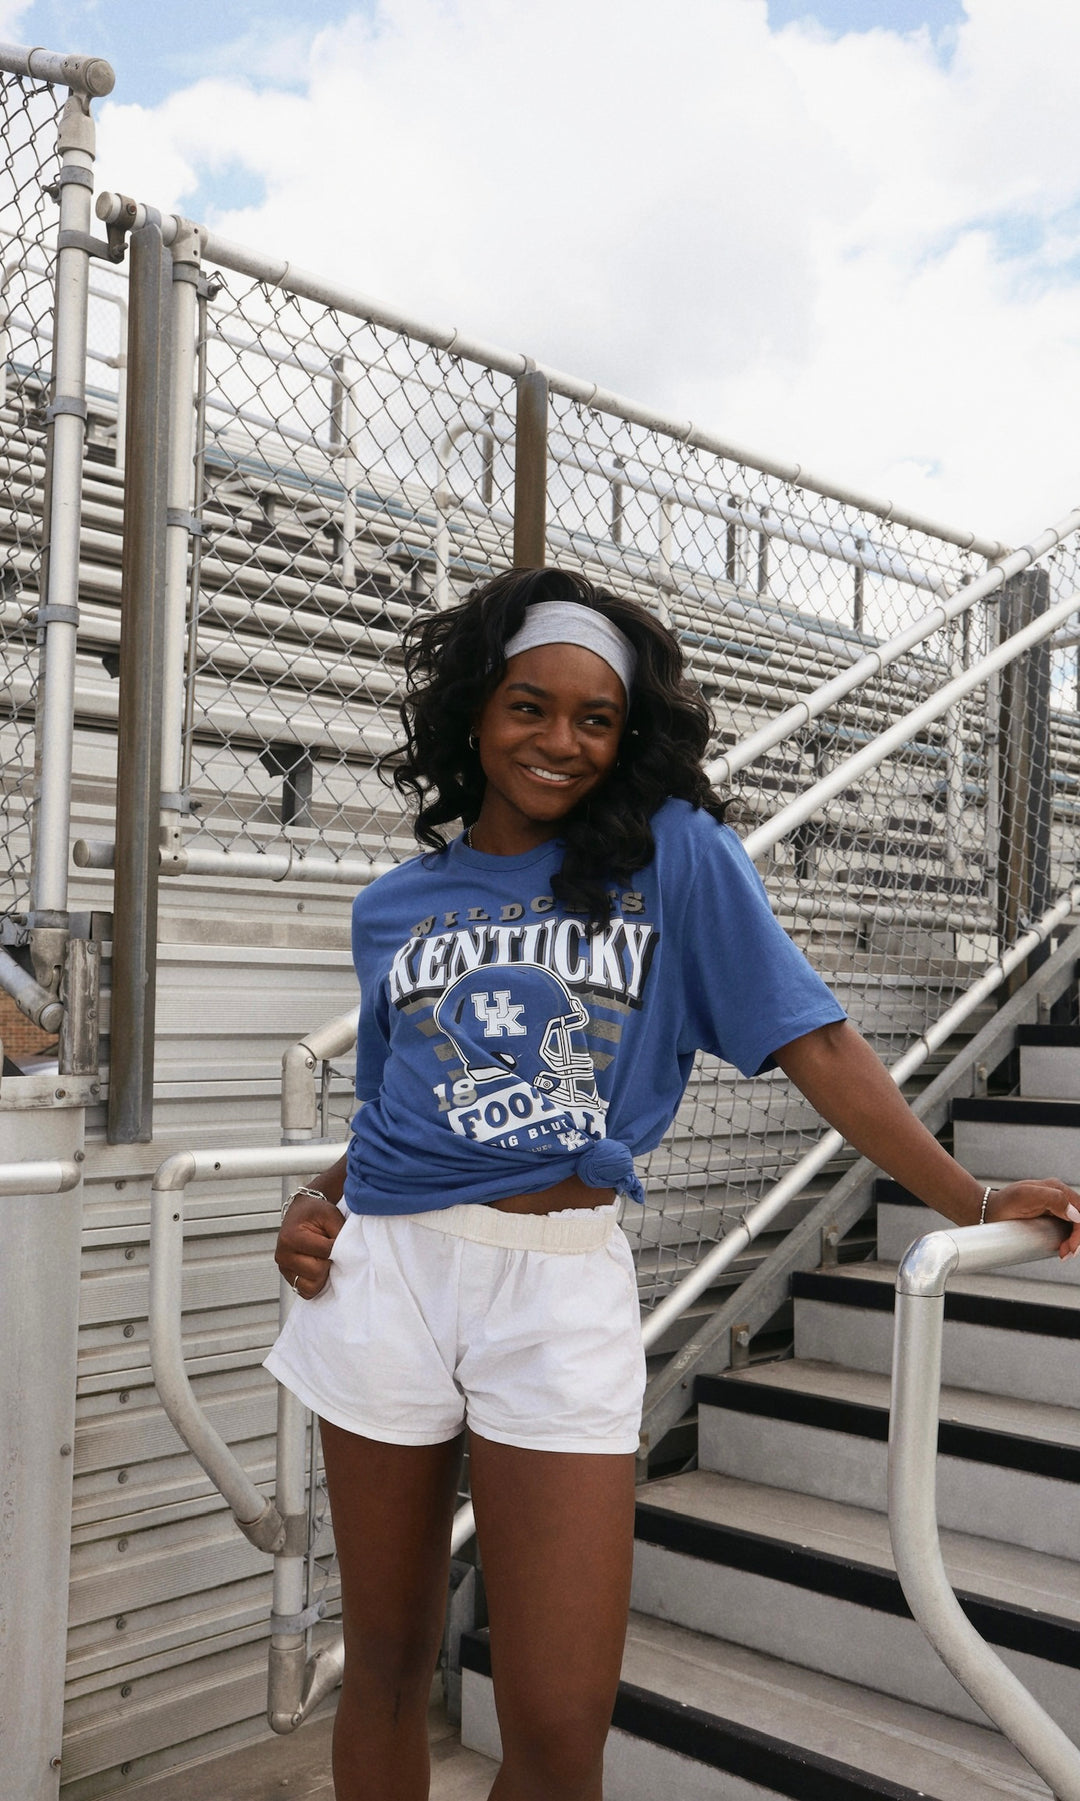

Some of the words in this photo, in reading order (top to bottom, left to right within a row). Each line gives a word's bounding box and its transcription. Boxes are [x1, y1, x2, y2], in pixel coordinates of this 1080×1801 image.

[409, 889, 646, 938] WILDCS
[389, 916, 656, 1002] KENTUCKY
[471, 990, 528, 1038] UK
[489, 1134, 519, 1149] IG
